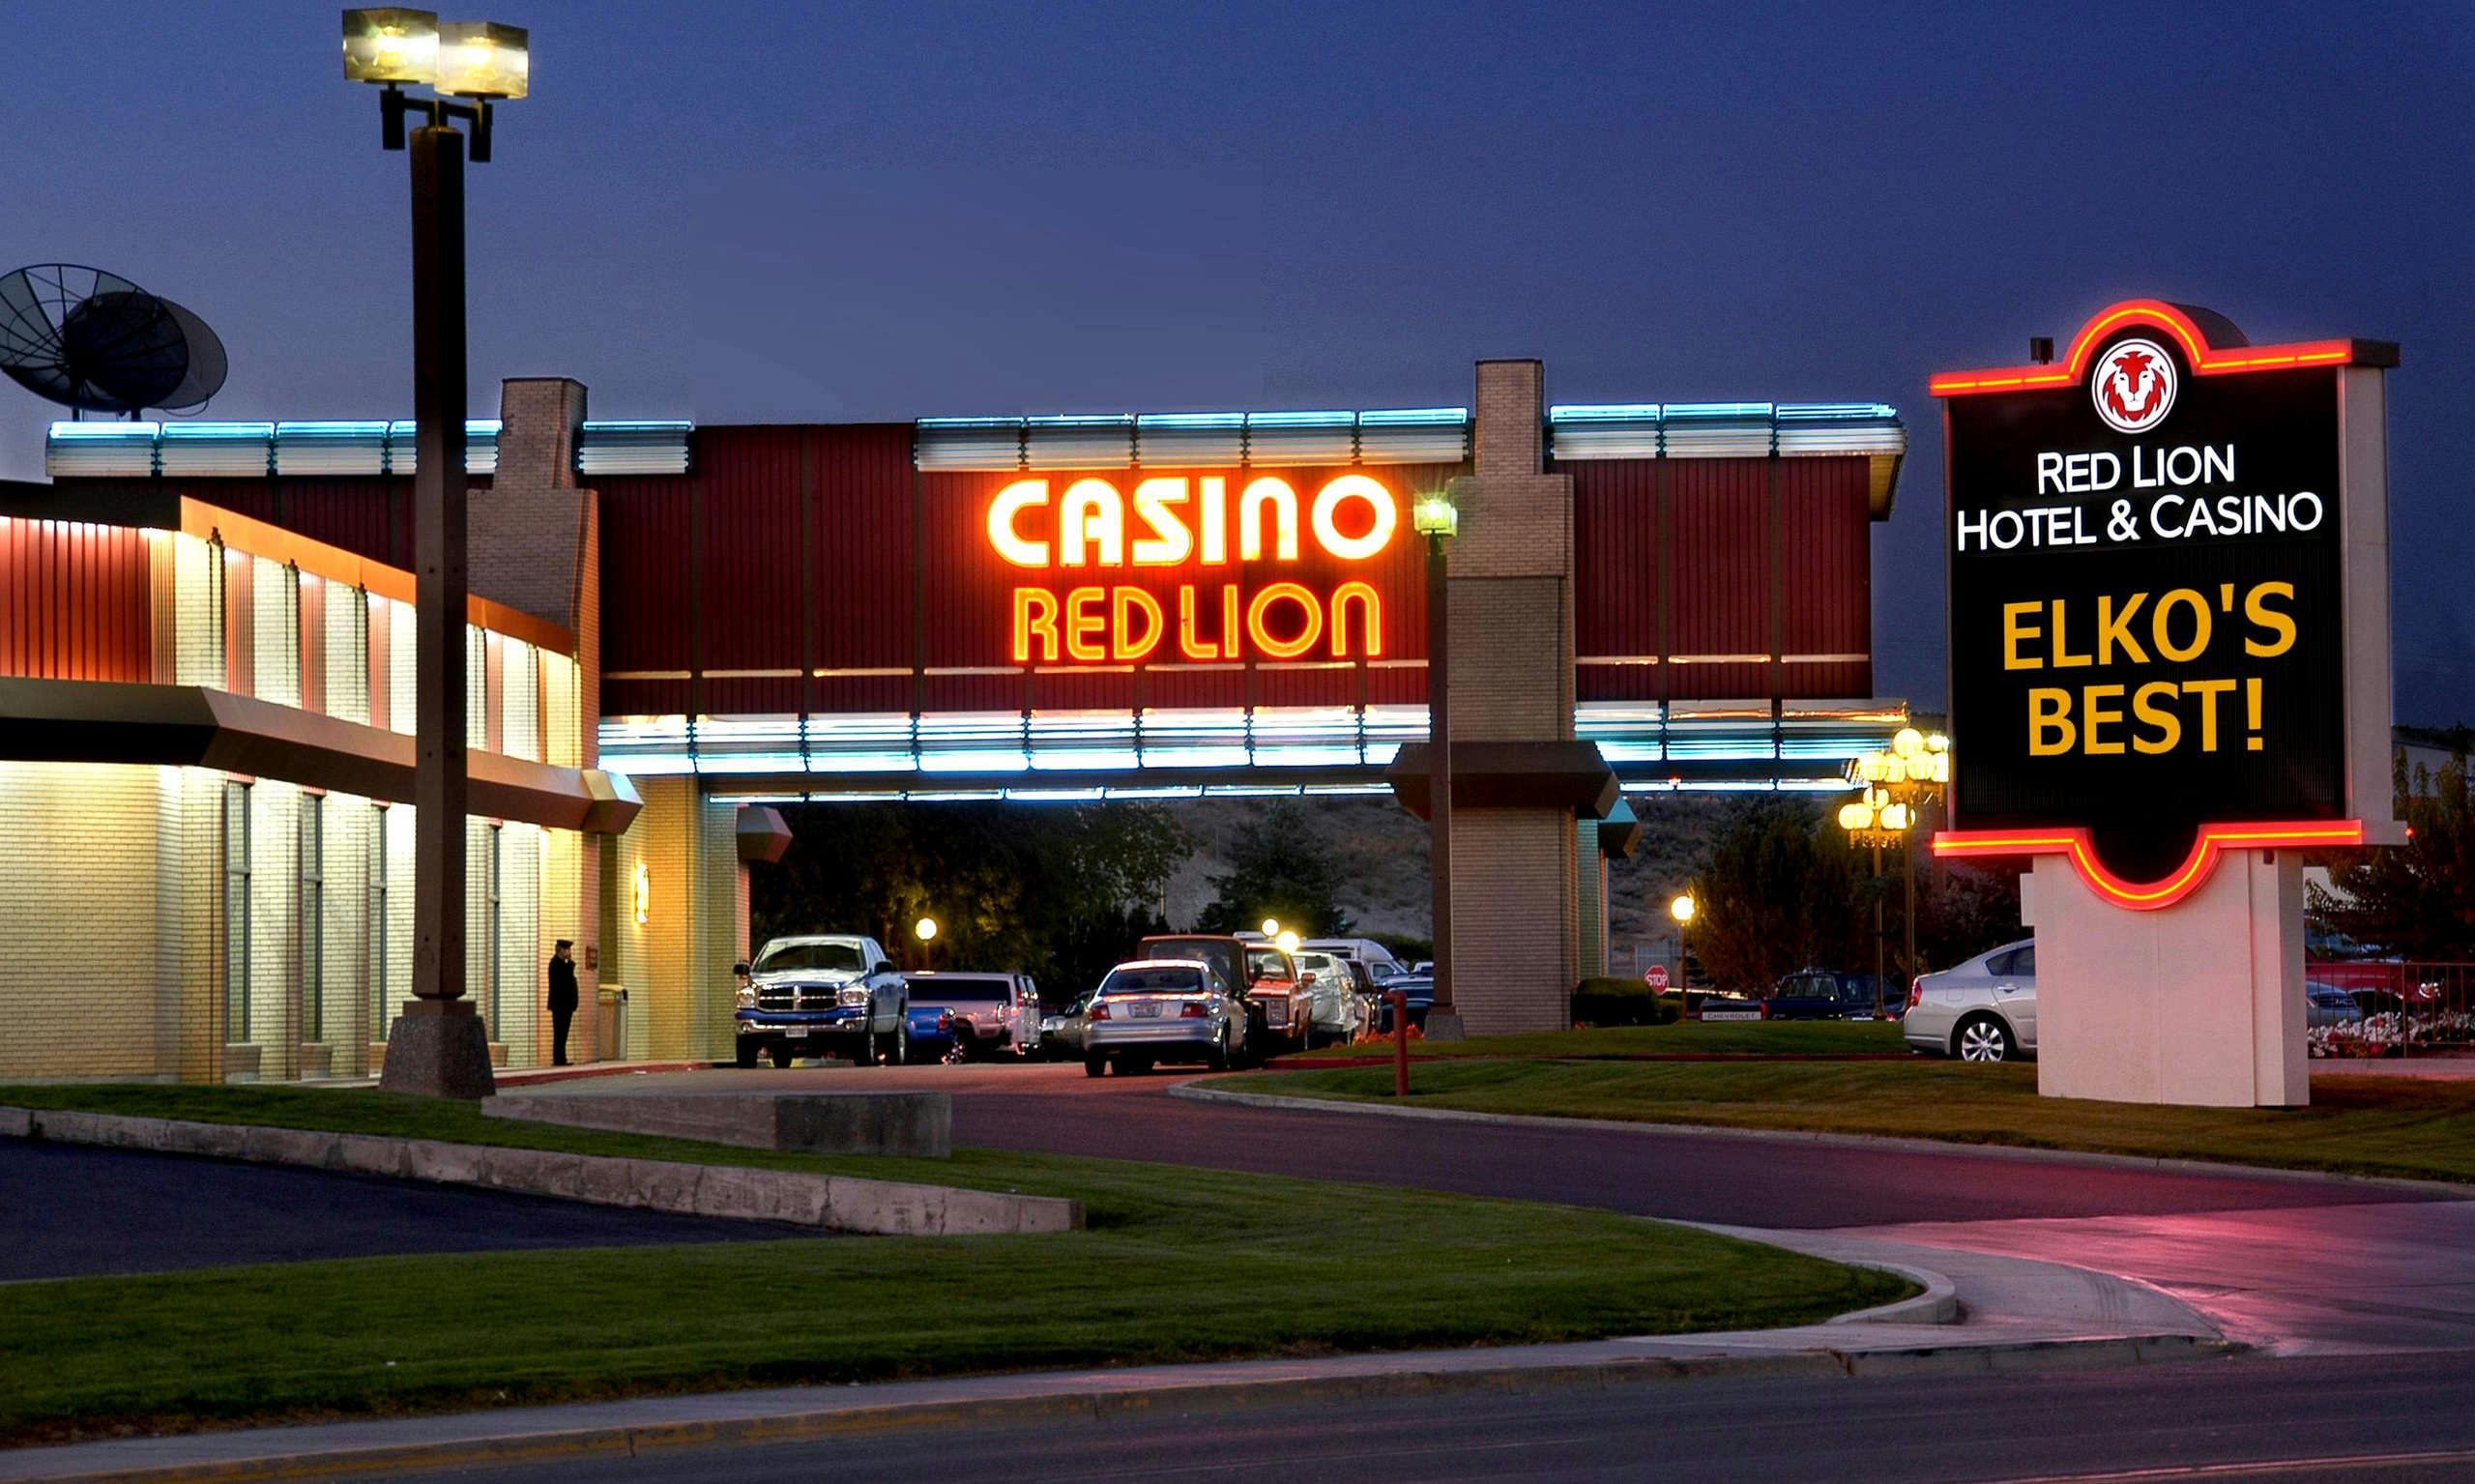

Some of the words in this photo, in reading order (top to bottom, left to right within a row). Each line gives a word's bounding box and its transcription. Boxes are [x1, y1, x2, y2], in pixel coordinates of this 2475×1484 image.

[2037, 451, 2121, 495] RED
[2133, 443, 2235, 488] LION
[986, 475, 1397, 567] CASINO
[1958, 506, 2098, 552] HOTEL
[2107, 498, 2141, 541] &
[2149, 491, 2323, 538] CASINO
[1013, 585, 1164, 661] RED
[1179, 581, 1383, 659] LION
[2003, 581, 2297, 671] ELKO'S
[2028, 677, 2264, 757] BEST!
[1646, 974, 1668, 986] STOP
